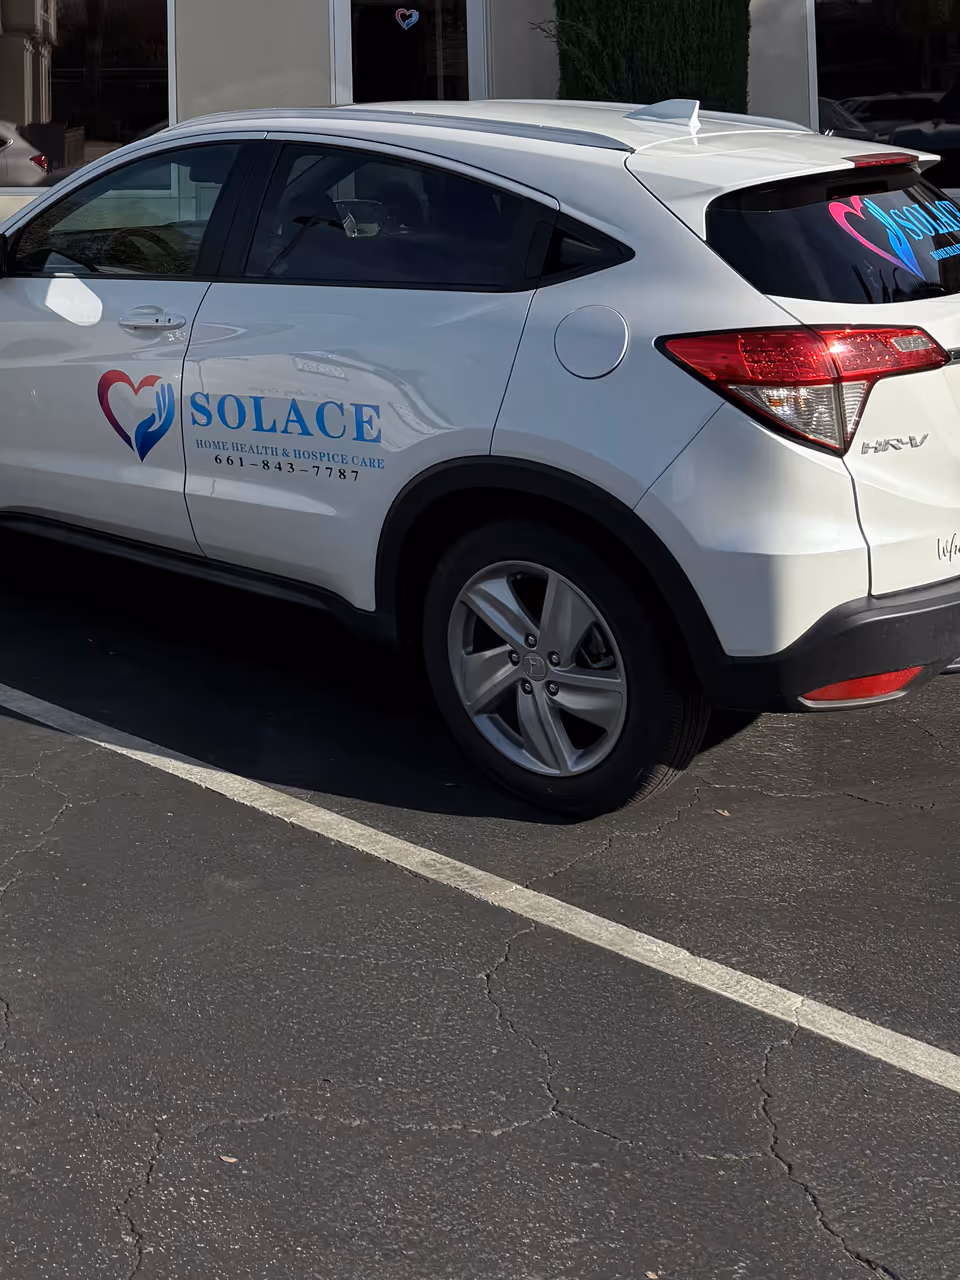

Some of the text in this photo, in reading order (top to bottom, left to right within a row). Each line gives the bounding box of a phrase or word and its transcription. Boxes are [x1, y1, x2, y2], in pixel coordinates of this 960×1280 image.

[190, 391, 383, 444] SOLACE
[195, 439, 385, 469] HOME HEALTH & HOSPICE CARE
[861, 433, 930, 455] HR-V
[214, 454, 359, 482] 661-843-7787
